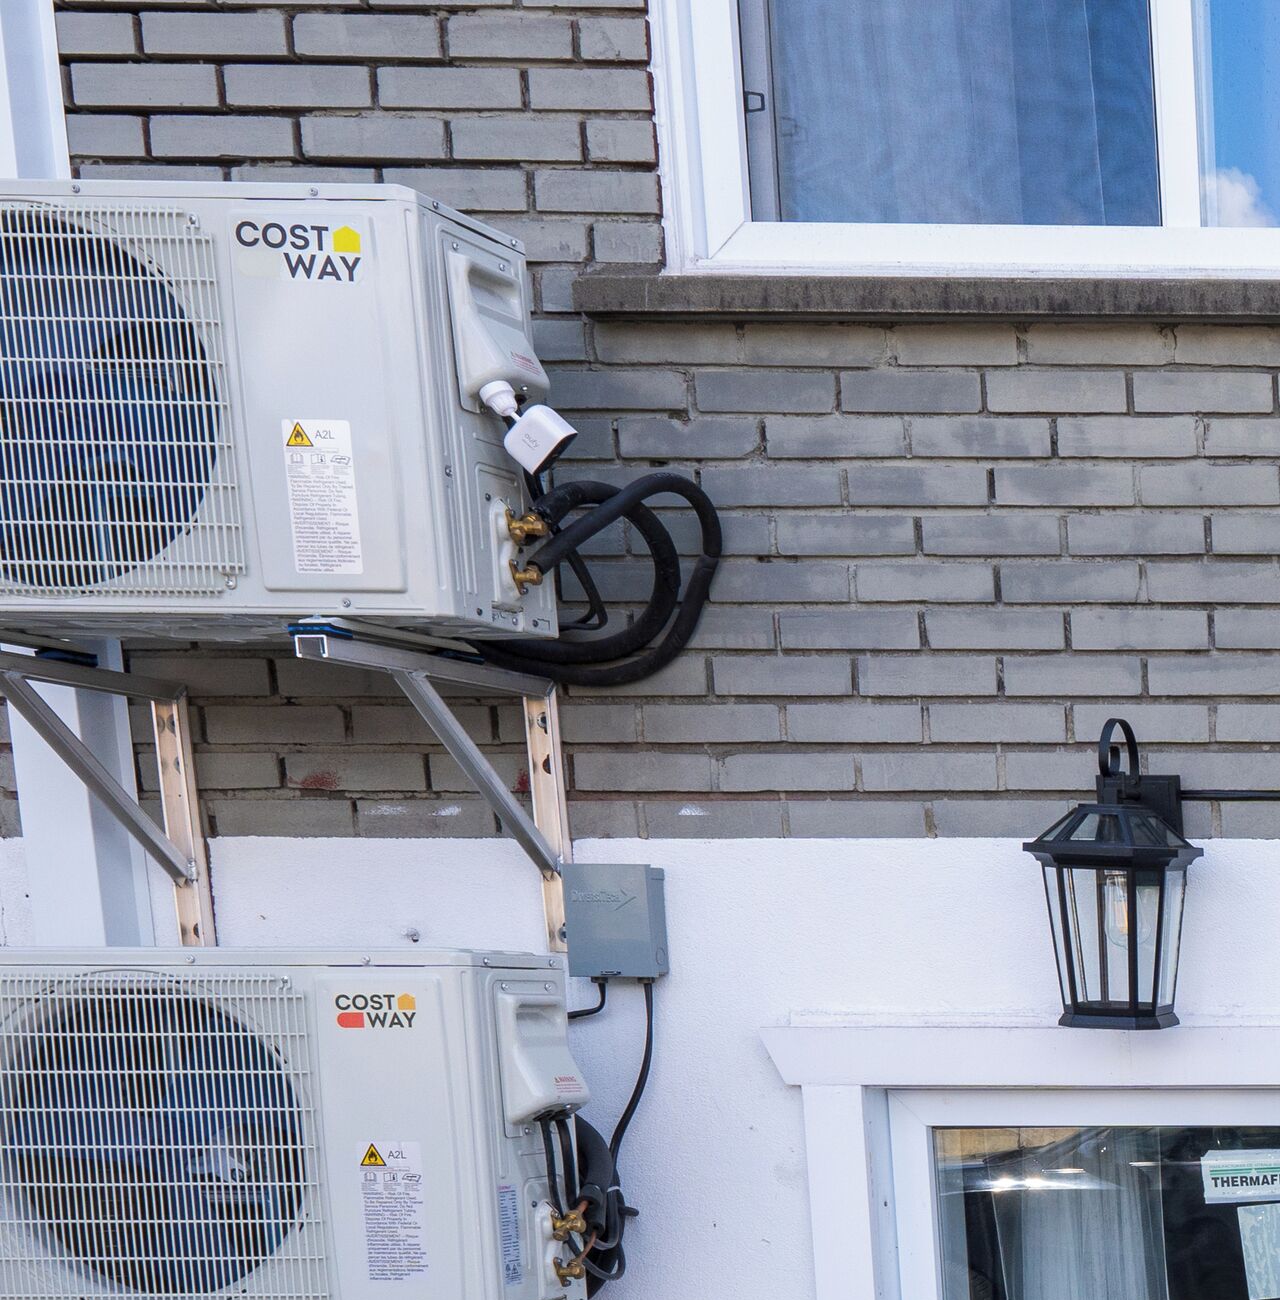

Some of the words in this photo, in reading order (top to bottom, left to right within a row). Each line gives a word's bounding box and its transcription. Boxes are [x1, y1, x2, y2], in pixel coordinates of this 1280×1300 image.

[235, 220, 329, 251] COST
[283, 252, 361, 282] WAY
[315, 430, 336, 440] A2L
[335, 994, 395, 1010] COST
[366, 1012, 416, 1028] WAY
[388, 1150, 407, 1159] A2L
